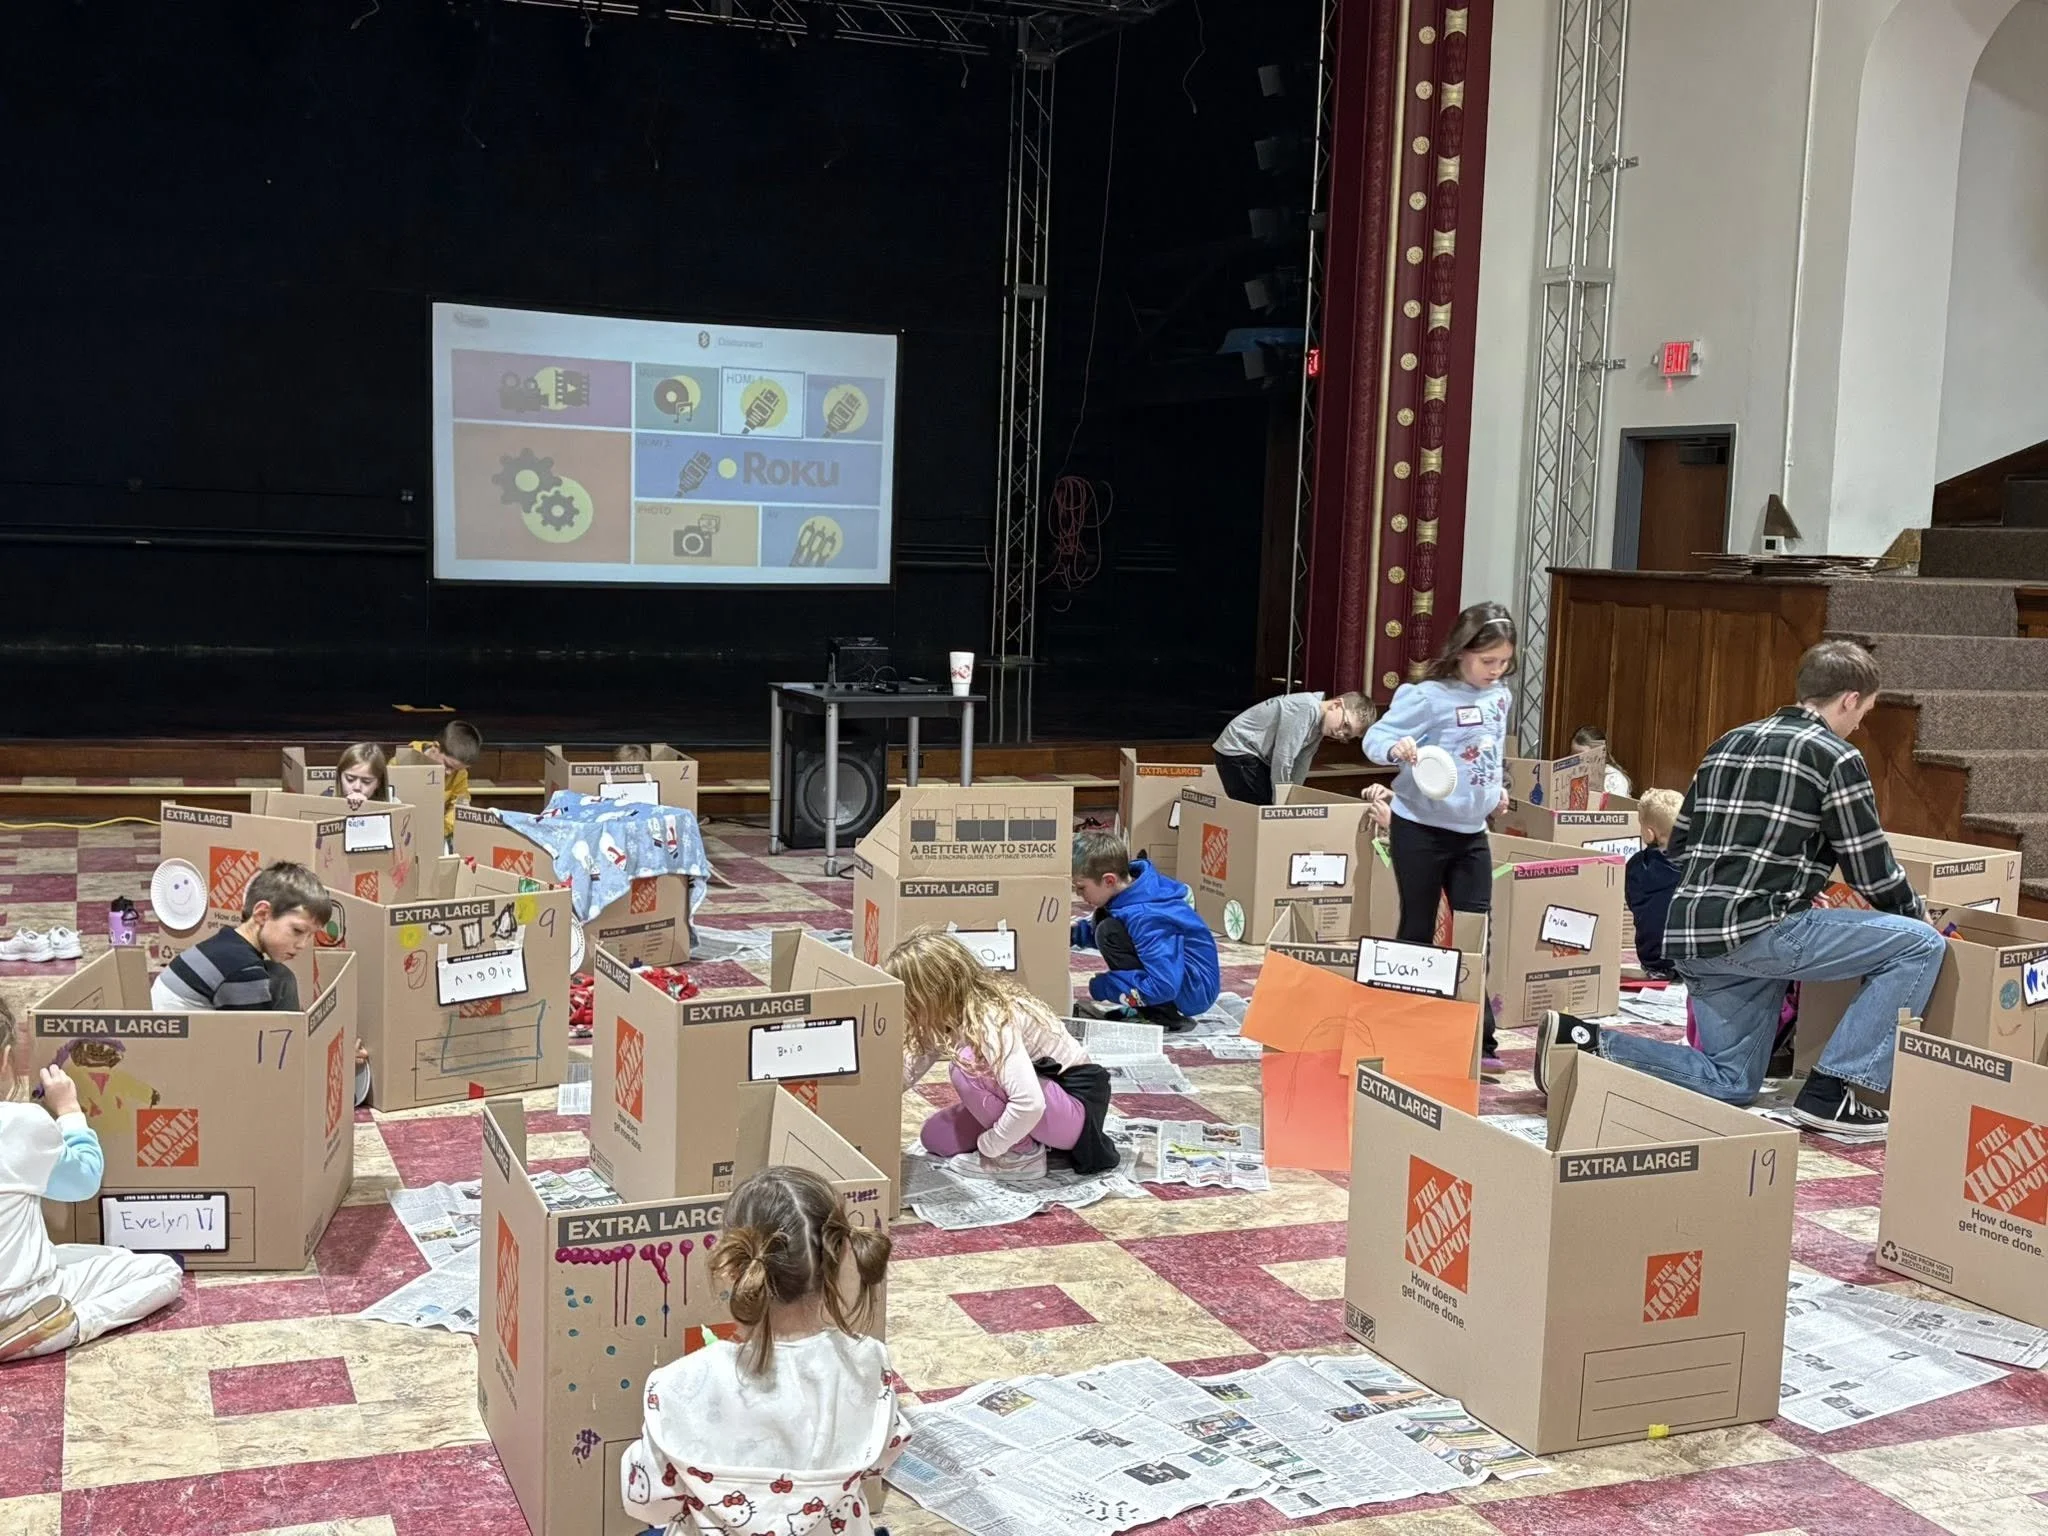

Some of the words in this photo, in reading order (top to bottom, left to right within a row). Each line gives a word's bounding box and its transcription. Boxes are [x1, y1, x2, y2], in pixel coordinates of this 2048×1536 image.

[575, 765, 605, 775] EXTRA
[608, 765, 641, 775] LARGE
[680, 764, 690, 780] 2
[1139, 767, 1168, 775] EXTRA
[1170, 767, 1200, 775] LARGE
[166, 810, 196, 823] EXTRA
[198, 814, 229, 826] LARGE
[457, 810, 482, 822] EXTRA
[1264, 808, 1294, 818] EXTRA
[1295, 808, 1325, 817] LARGE
[1560, 814, 1592, 823] EXTRA
[1594, 814, 1625, 823] LARGE
[910, 845, 918, 854] A
[922, 844, 968, 854] BETTER
[971, 844, 997, 854] WAY
[999, 844, 1016, 853] TO
[1018, 843, 1056, 853] STACK
[209, 851, 261, 908] HOME
[215, 854, 236, 879] THE
[1518, 868, 1546, 877] EXTRA
[1548, 866, 1577, 875] LARGE
[1605, 865, 1615, 888] 11
[1936, 867, 1959, 876] EXTRA
[1960, 862, 1984, 873] LARGE
[2006, 861, 2016, 881] 12
[905, 884, 948, 894] EXTRA
[951, 883, 994, 893] LARGE
[395, 907, 442, 922] EXTRA
[445, 902, 490, 918] LARGE
[539, 907, 555, 938] 9
[1036, 895, 1060, 923] 10
[1281, 949, 1326, 963] XTRA
[1374, 945, 1434, 977] Evan's
[2003, 951, 2034, 965] EXTRA
[596, 955, 612, 978] EXTRA
[612, 966, 630, 989] LARGE
[690, 1002, 746, 1021] EXTRA
[749, 998, 805, 1016] LARGE
[861, 1001, 887, 1038] 16
[43, 1019, 109, 1034] EXTRA
[115, 1019, 181, 1034] LARGE
[257, 1029, 293, 1070] 17
[1903, 1036, 1951, 1062] EXTRA
[1955, 1049, 2006, 1077] LARGE
[1361, 1073, 1397, 1105] EXTRA
[1399, 1091, 1438, 1124] LARGE
[137, 1109, 198, 1167] HOME
[143, 1114, 168, 1138] THE
[160, 1131, 198, 1167] DEPOT
[1975, 1123, 2012, 1158] THE
[1567, 1157, 1628, 1177] EXTRA
[1632, 1150, 1692, 1171] LARGE
[1747, 1147, 1777, 1198] 19
[1413, 1176, 1441, 1215] THE
[120, 1210, 190, 1234] Evelyn
[195, 1207, 214, 1231] 17
[568, 1214, 652, 1240] EXTRA
[658, 1207, 723, 1232] LARG
[1405, 1178, 1472, 1266] HOME
[1971, 1207, 1997, 1226] How
[1999, 1218, 2033, 1239] doers
[1428, 1222, 1470, 1278] DEPOT
[1958, 1219, 1977, 1234] get
[1979, 1226, 2009, 1245] more
[2011, 1236, 2044, 1257] done.
[1650, 1260, 1676, 1288] THE
[1901, 1251, 1918, 1262] MADE
[1918, 1256, 1936, 1268] FROM
[1935, 1263, 1950, 1274] 100%
[1901, 1258, 1931, 1273] RECYCLED
[1931, 1268, 1950, 1280] PAPER
[1410, 1270, 1431, 1292] How
[1431, 1284, 1458, 1309] doers
[1644, 1250, 1702, 1321] HOME
[1665, 1274, 1701, 1318] DEPOT
[1401, 1284, 1416, 1300] get
[1416, 1293, 1440, 1315] more
[1441, 1306, 1467, 1331] done.
